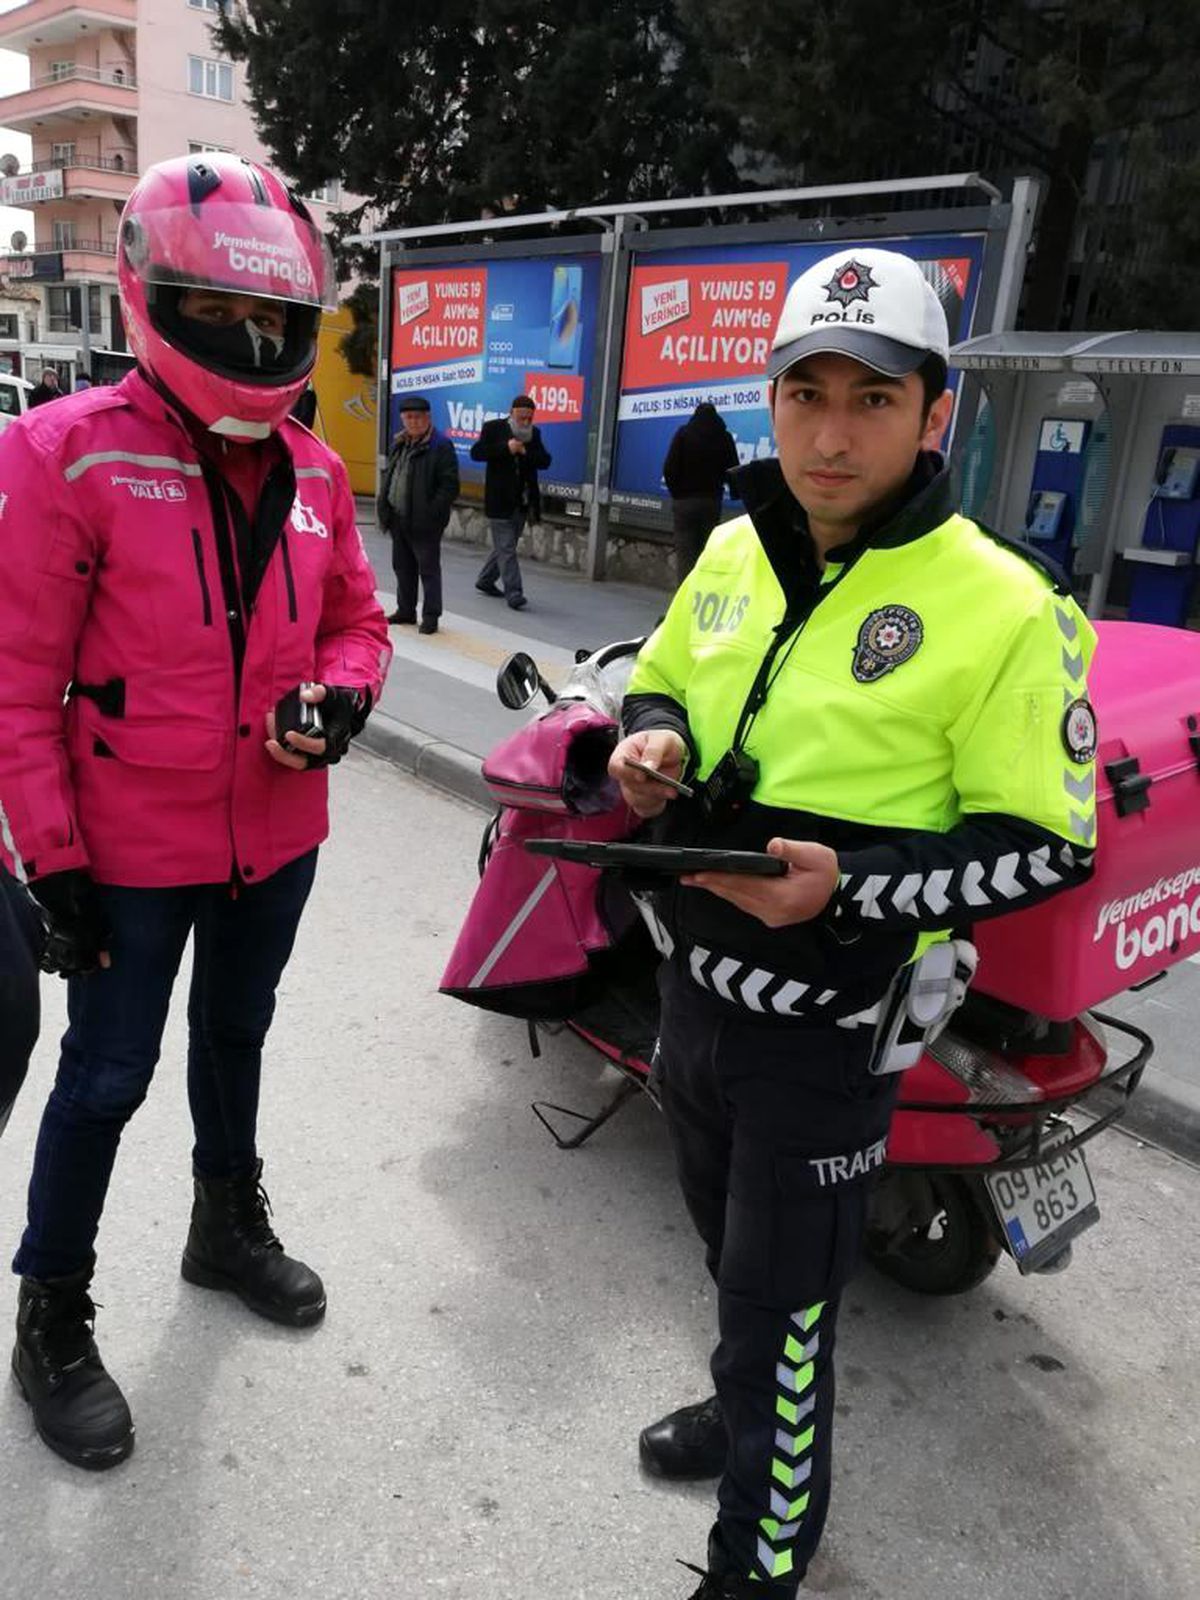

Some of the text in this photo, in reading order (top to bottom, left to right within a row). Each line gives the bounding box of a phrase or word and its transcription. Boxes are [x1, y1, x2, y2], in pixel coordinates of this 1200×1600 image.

[435, 281, 481, 298] YUNUS 19
[654, 286, 677, 307] YENİ
[700, 280, 776, 301] YUNUS 19
[712, 308, 772, 328] AVM'de
[412, 325, 478, 350] AÇILIYOR
[660, 335, 768, 366] AÇILIYOR
[1108, 359, 1183, 373] TELEFON
[733, 390, 761, 404] 10:00
[996, 1170, 1029, 1210] 09
[1034, 1179, 1078, 1230] 863
